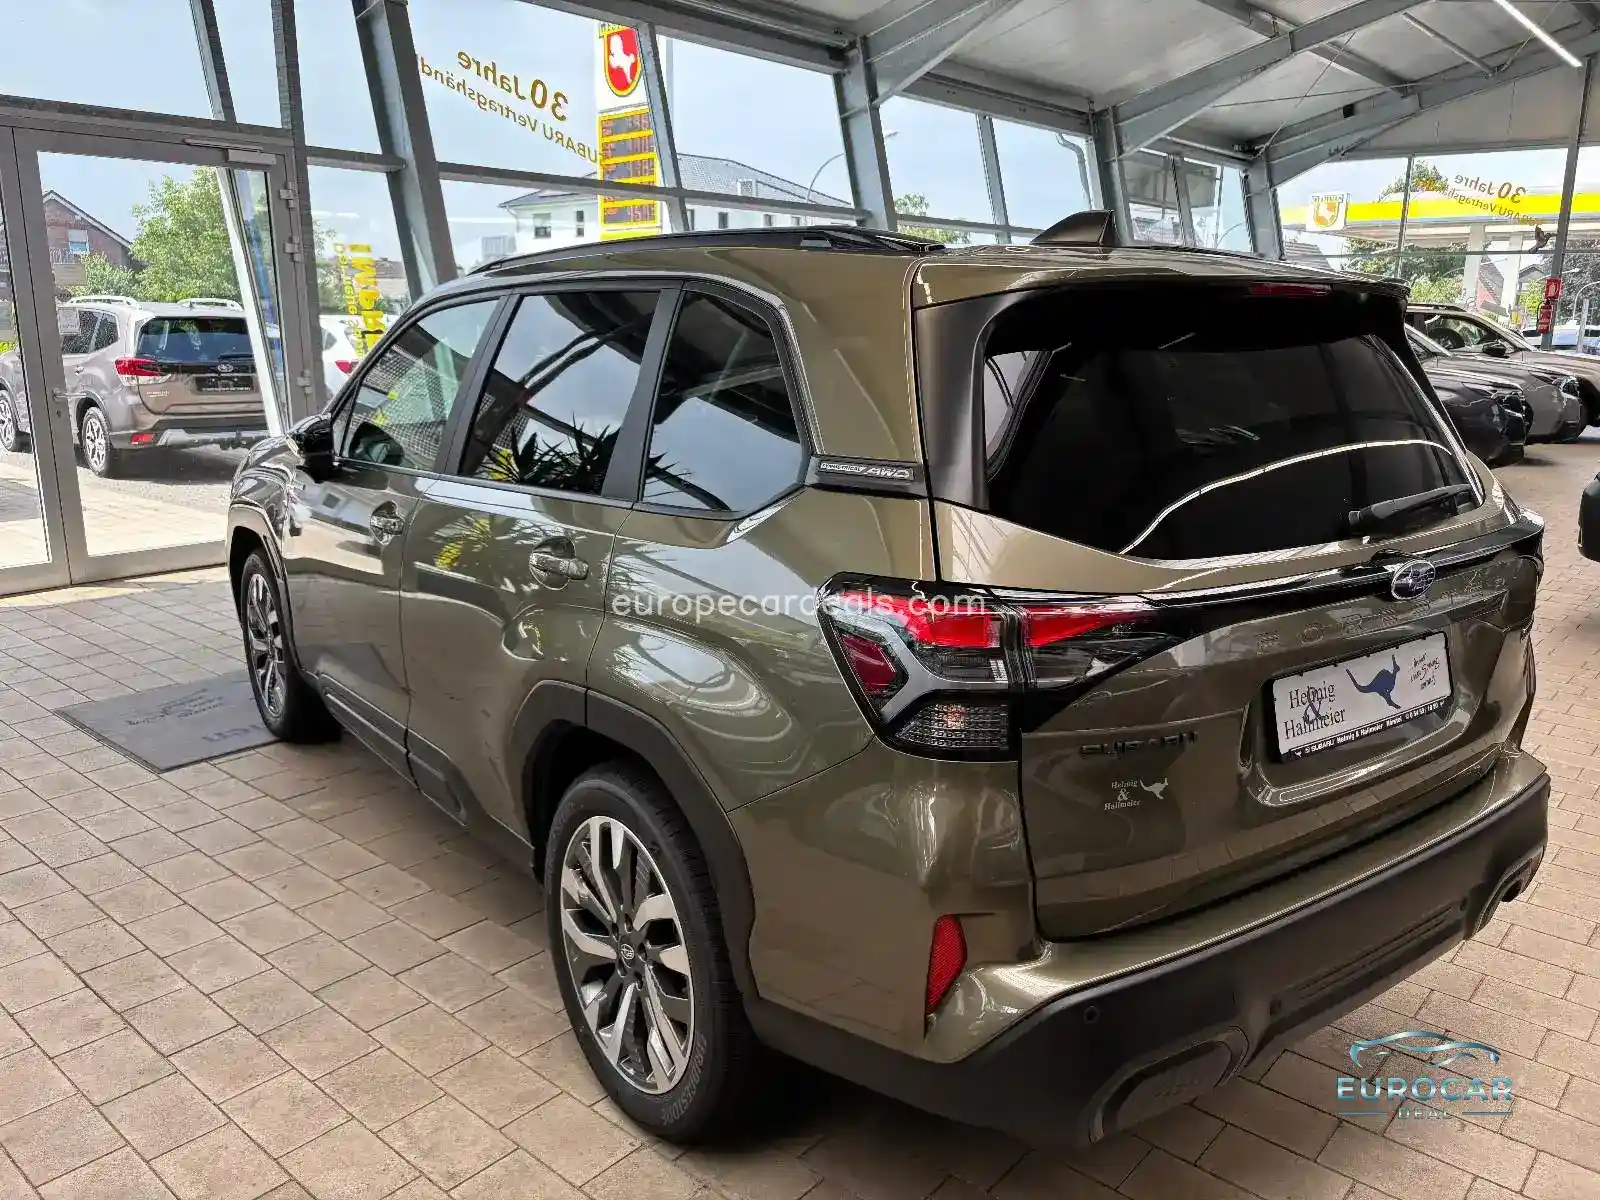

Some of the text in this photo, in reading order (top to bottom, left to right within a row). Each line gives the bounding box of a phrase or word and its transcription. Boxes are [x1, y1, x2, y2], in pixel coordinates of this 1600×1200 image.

[863, 466, 910, 479] AWD
[1311, 739, 1335, 752] SUBARU
[1117, 788, 1131, 801] &
